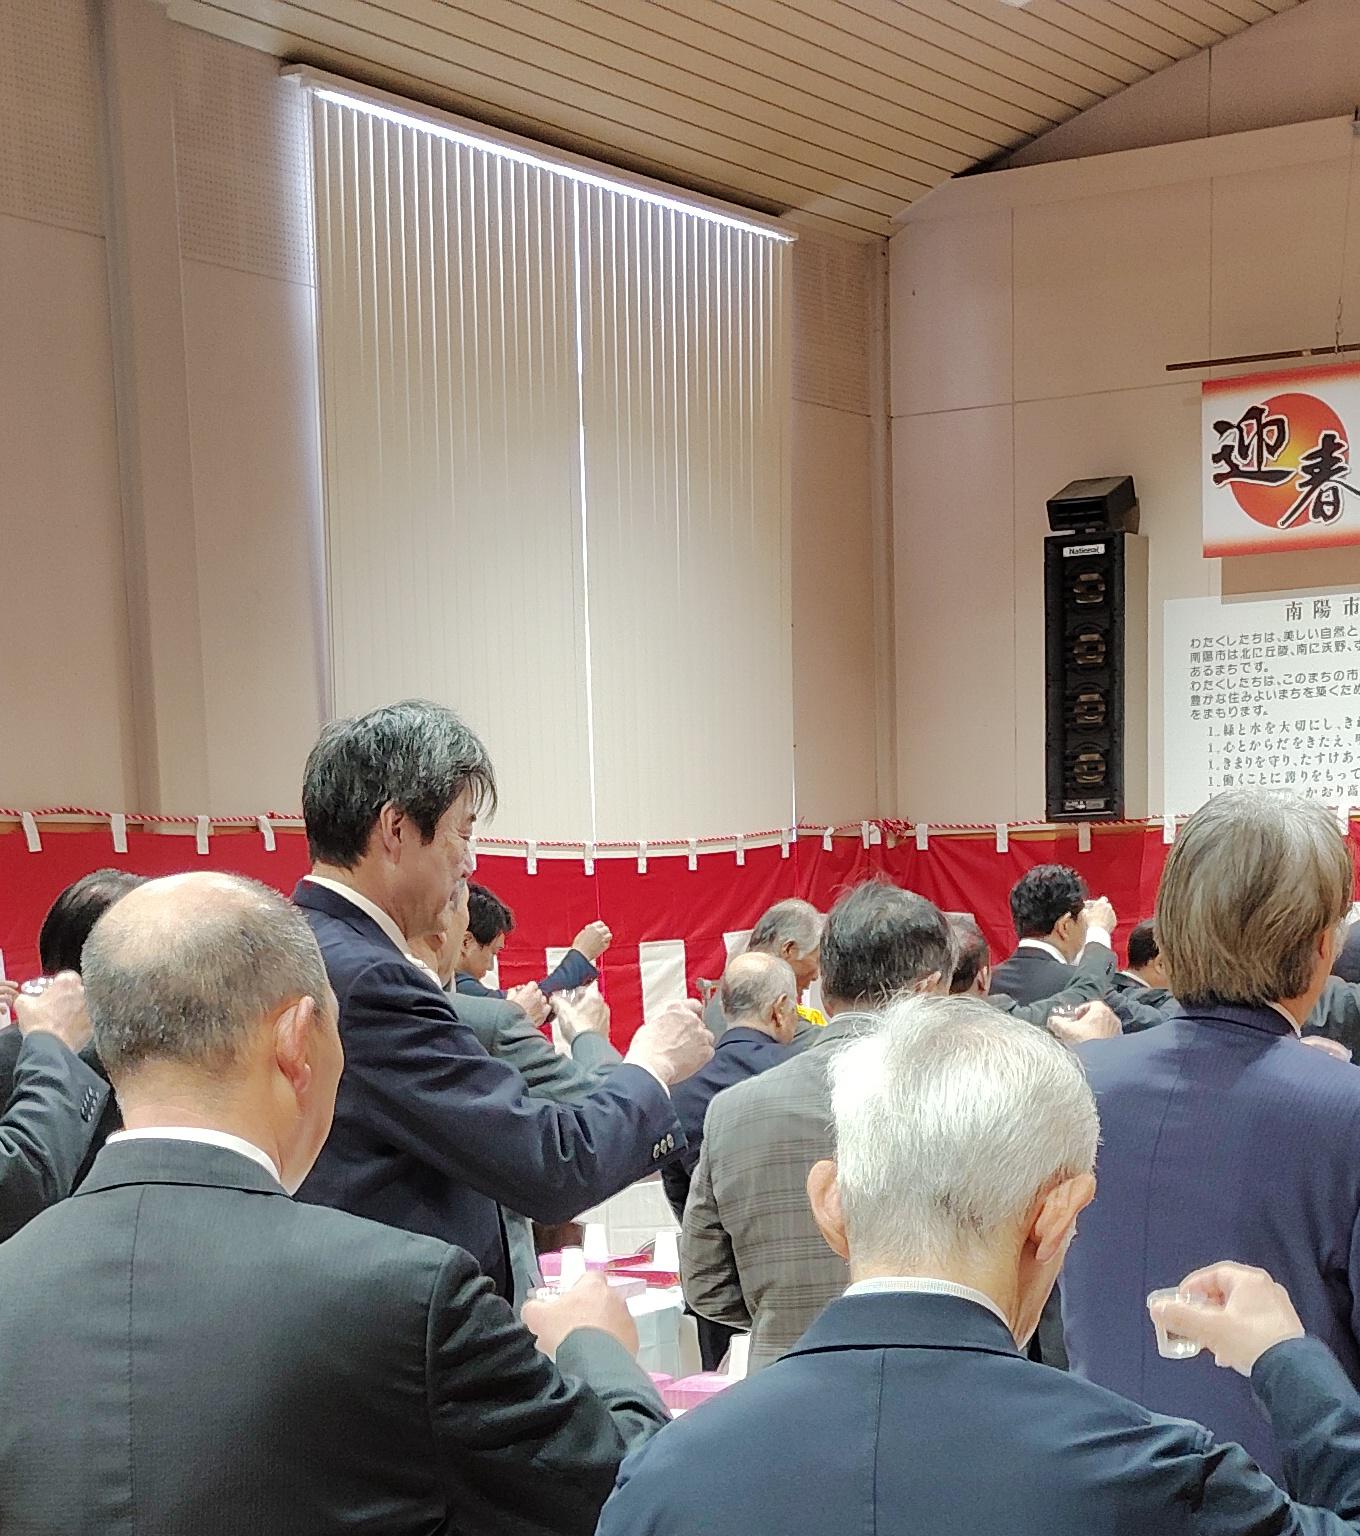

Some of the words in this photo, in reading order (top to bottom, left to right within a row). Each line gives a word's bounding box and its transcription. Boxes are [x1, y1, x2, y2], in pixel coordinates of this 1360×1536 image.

[1068, 546, 1100, 555] National
[1190, 662, 1268, 677] あるまちです。
